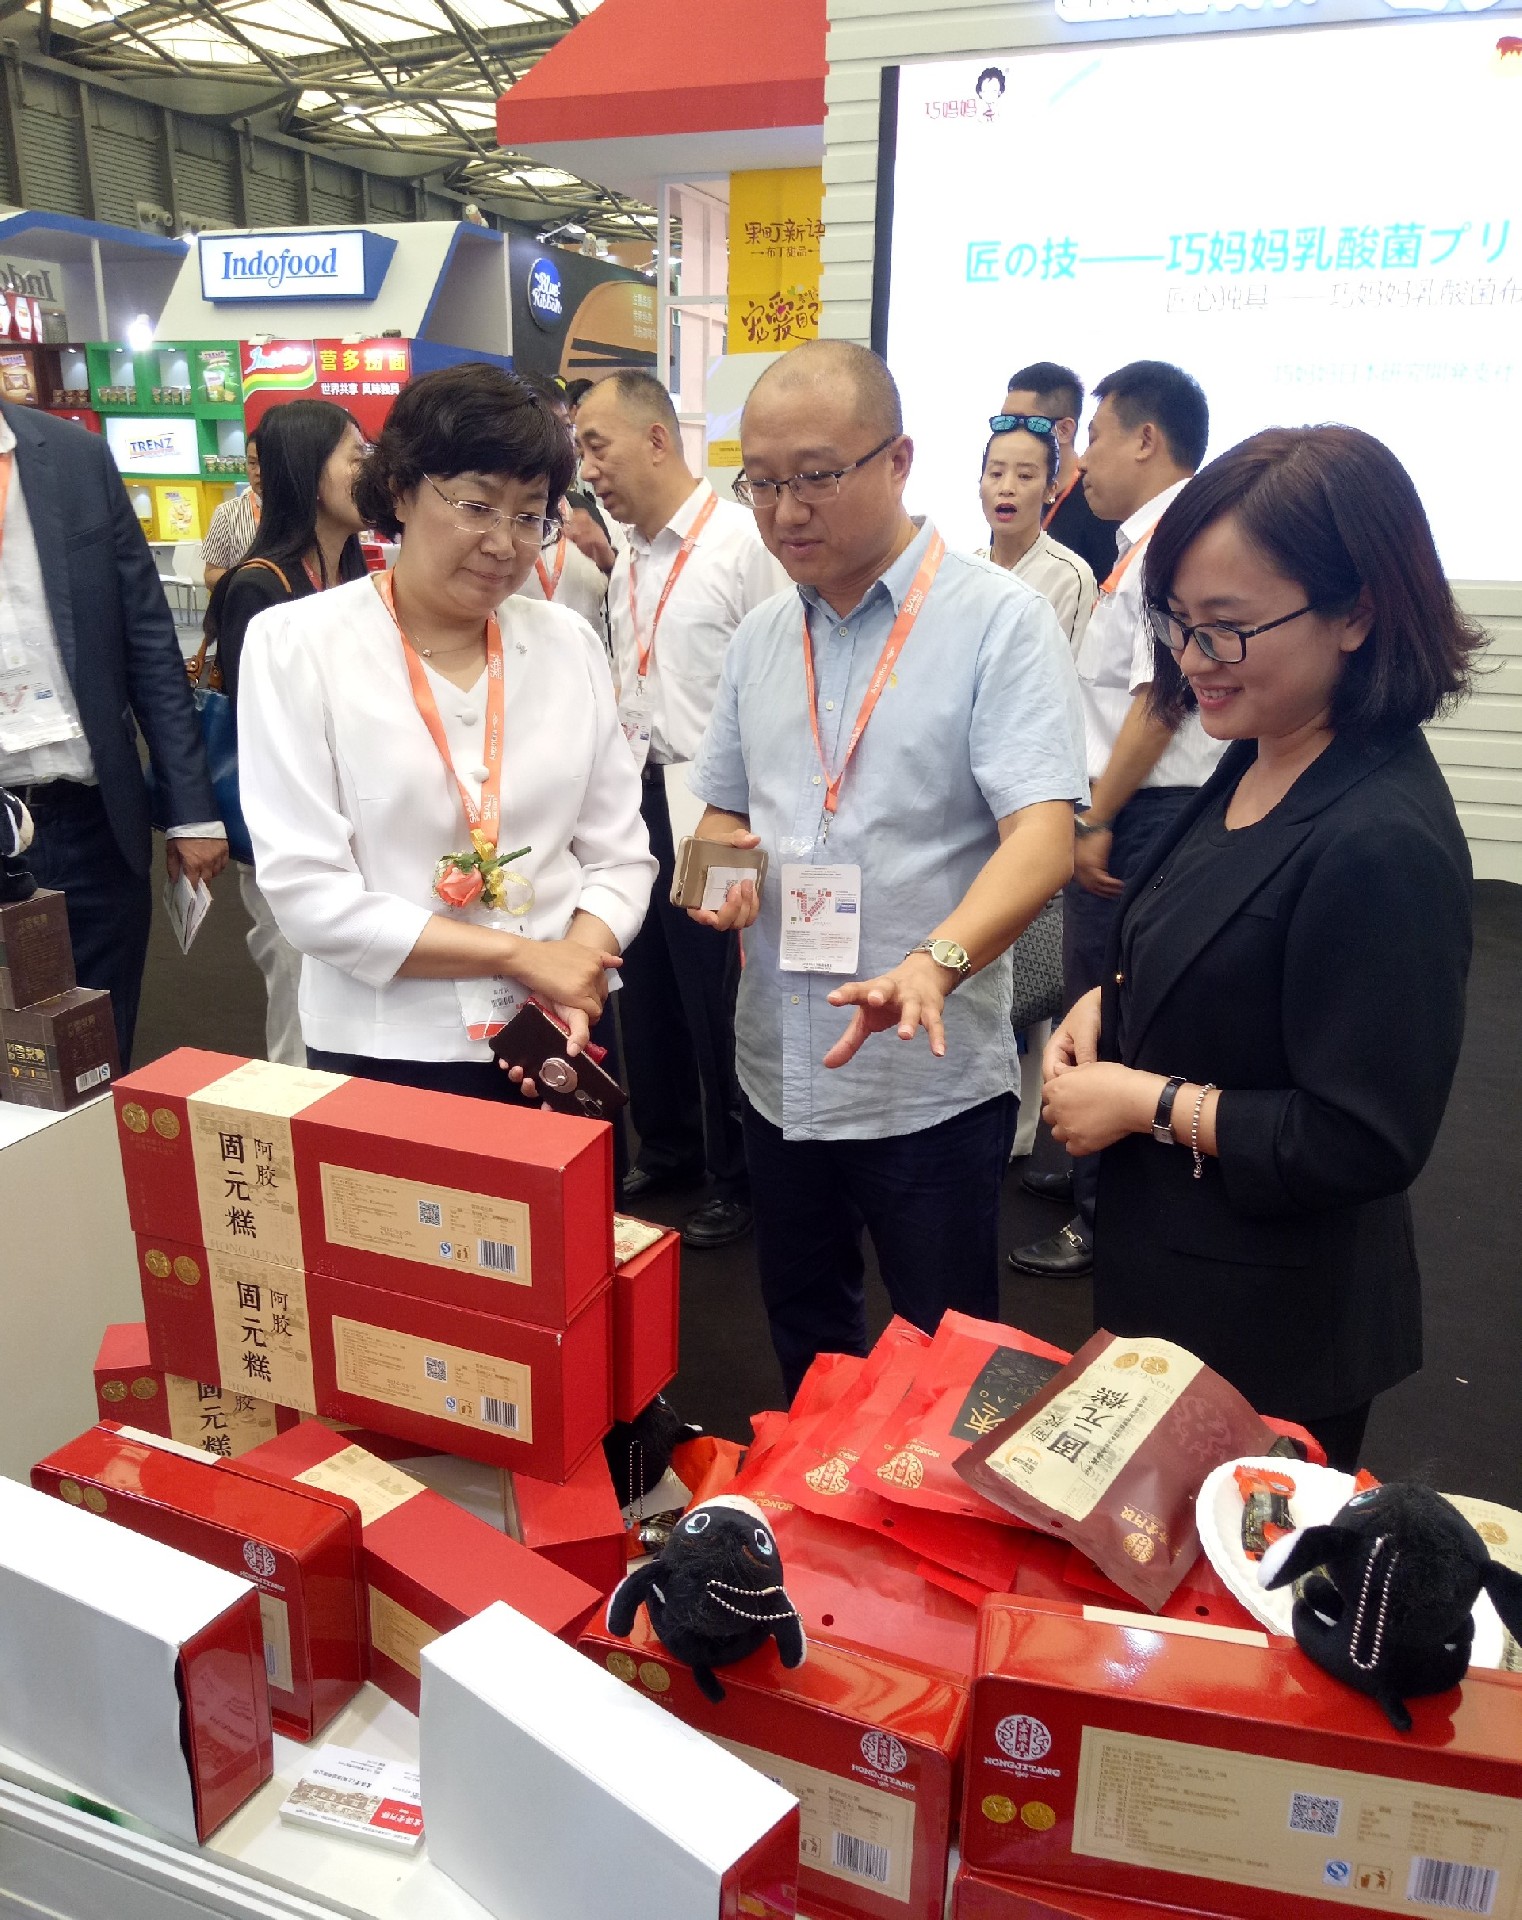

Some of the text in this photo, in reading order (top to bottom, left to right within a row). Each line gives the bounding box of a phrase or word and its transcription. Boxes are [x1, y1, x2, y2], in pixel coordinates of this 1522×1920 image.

[221, 248, 338, 288] Indofood
[535, 272, 561, 296] Blue
[532, 288, 562, 314] Ribbon
[130, 438, 174, 453] TRENZ
[218, 1132, 257, 1238] 固元糕
[254, 1138, 279, 1188] 阿胶
[237, 1281, 272, 1382] 固元糕
[270, 1288, 293, 1336] 阿胶
[197, 1381, 231, 1456] 固元糕
[1047, 1387, 1134, 1463] 固元糕
[983, 1756, 1061, 1778] HONGJITANG
